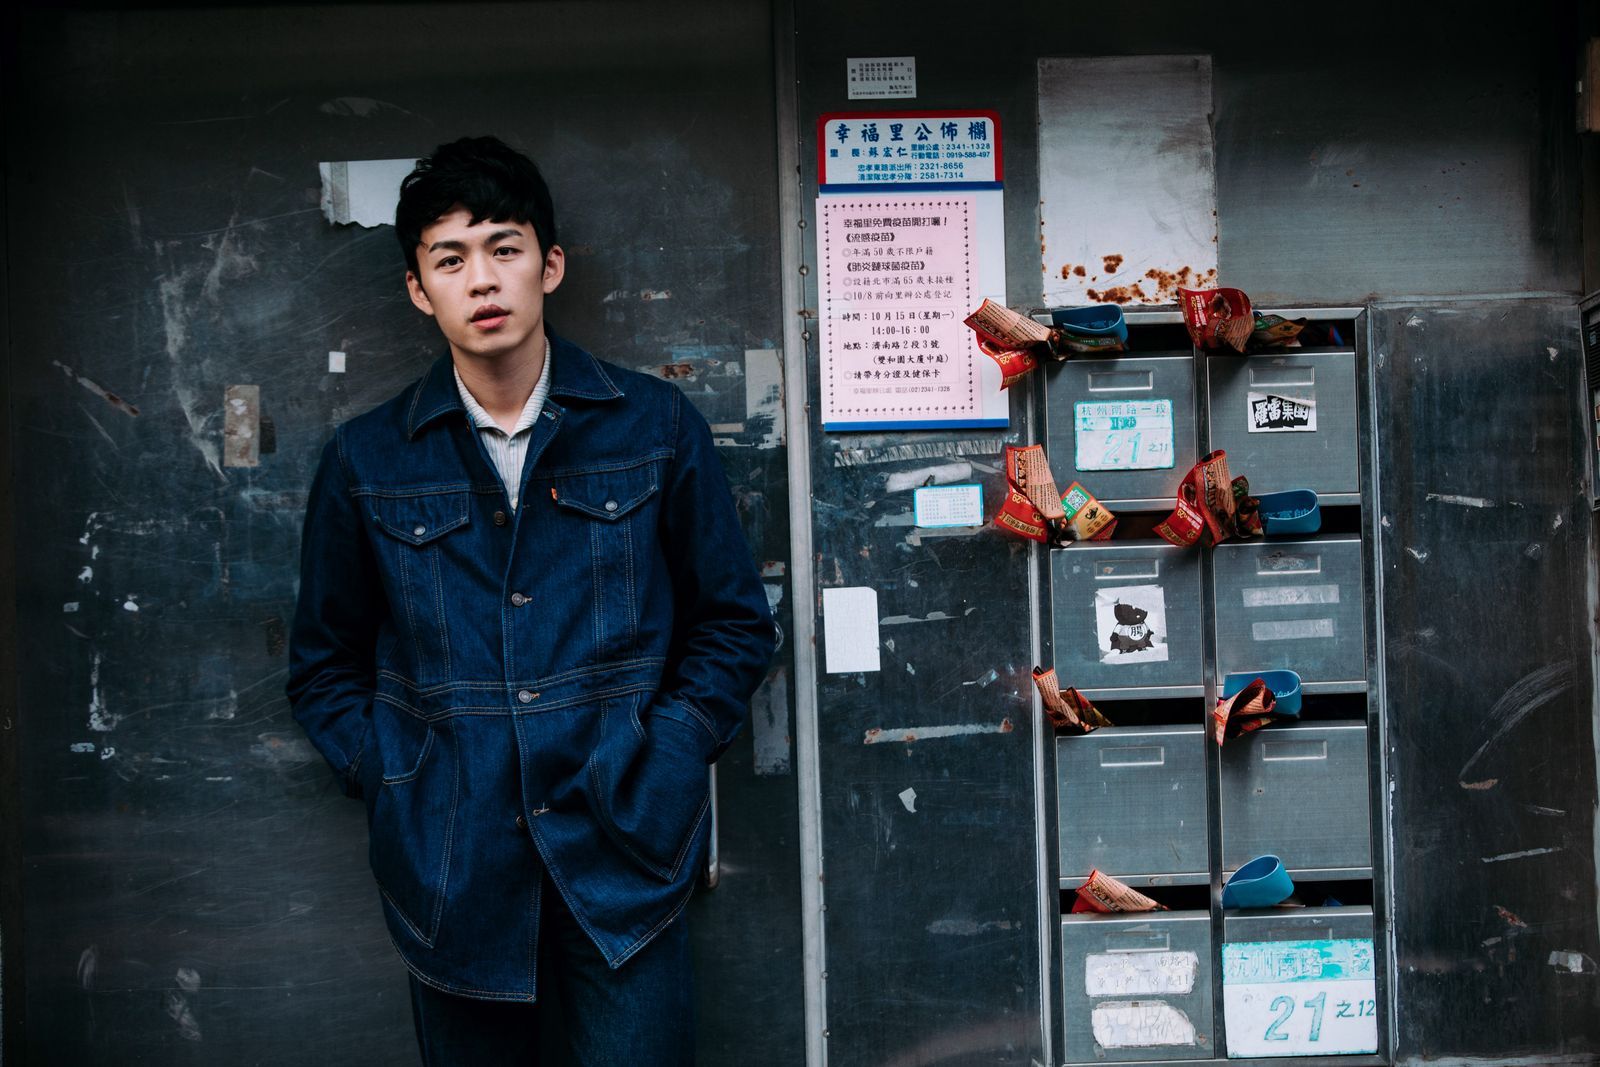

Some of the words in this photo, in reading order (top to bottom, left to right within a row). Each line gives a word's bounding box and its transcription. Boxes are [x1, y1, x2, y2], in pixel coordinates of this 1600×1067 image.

[835, 121, 987, 144] 幸福里公佈欄
